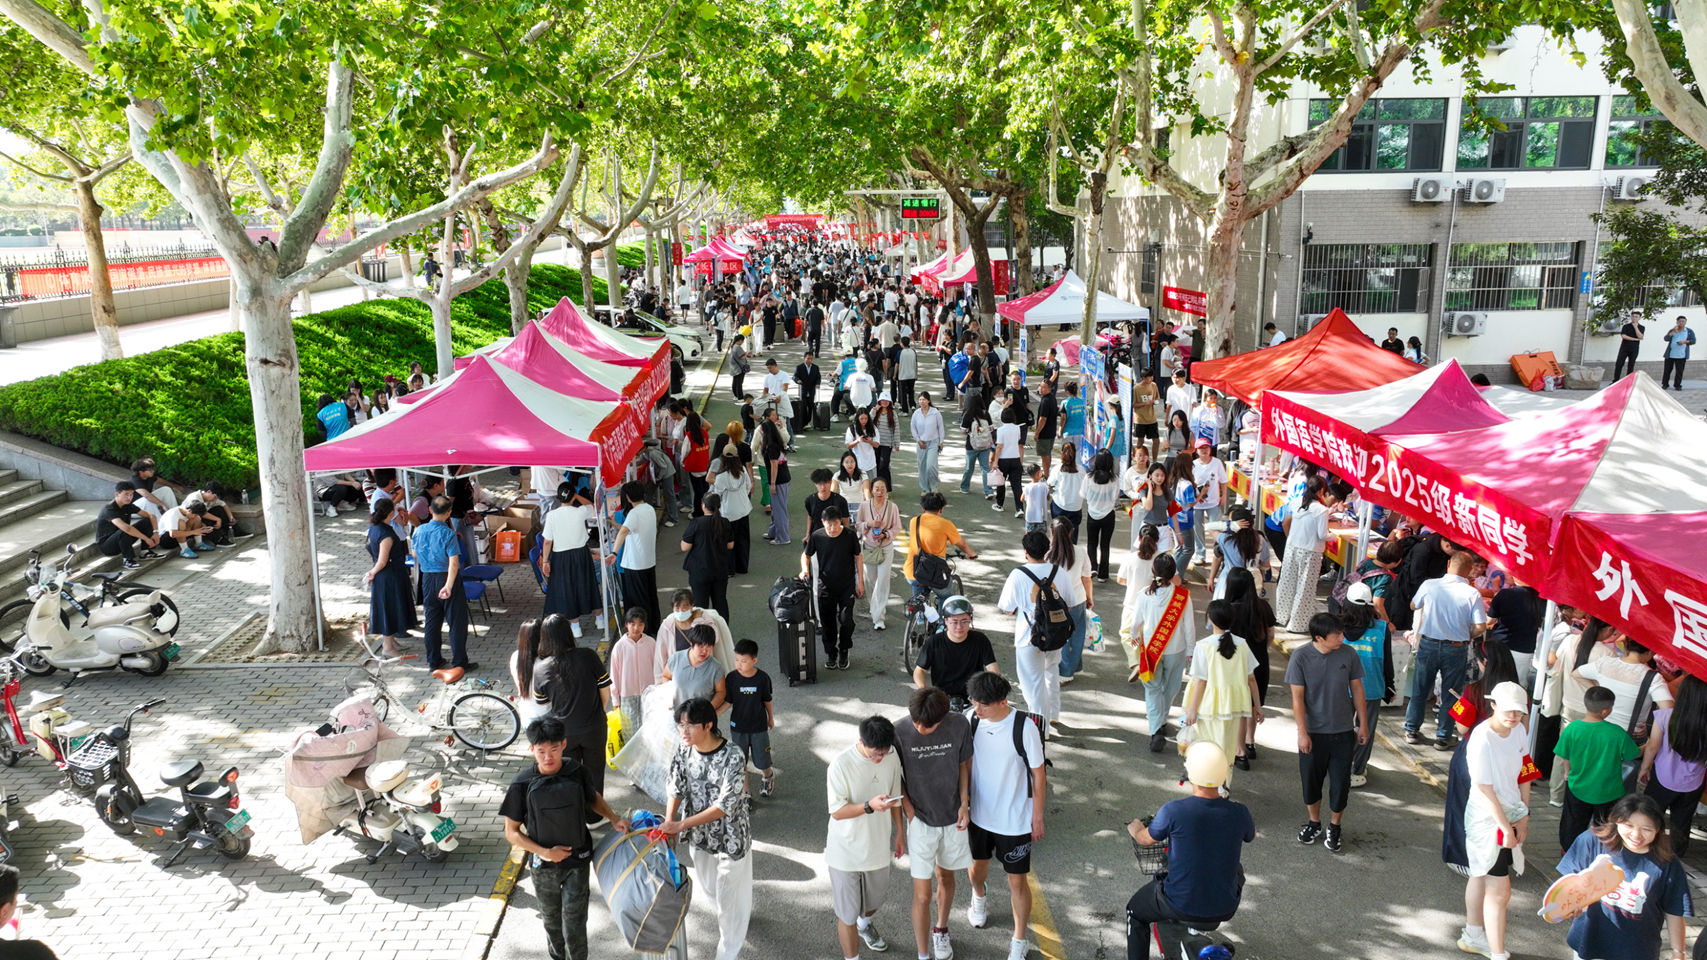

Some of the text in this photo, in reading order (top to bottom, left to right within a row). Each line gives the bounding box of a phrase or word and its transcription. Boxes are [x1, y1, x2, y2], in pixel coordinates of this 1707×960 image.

[1271, 406, 1534, 566] 外国语学院欢迎2025级新同学
